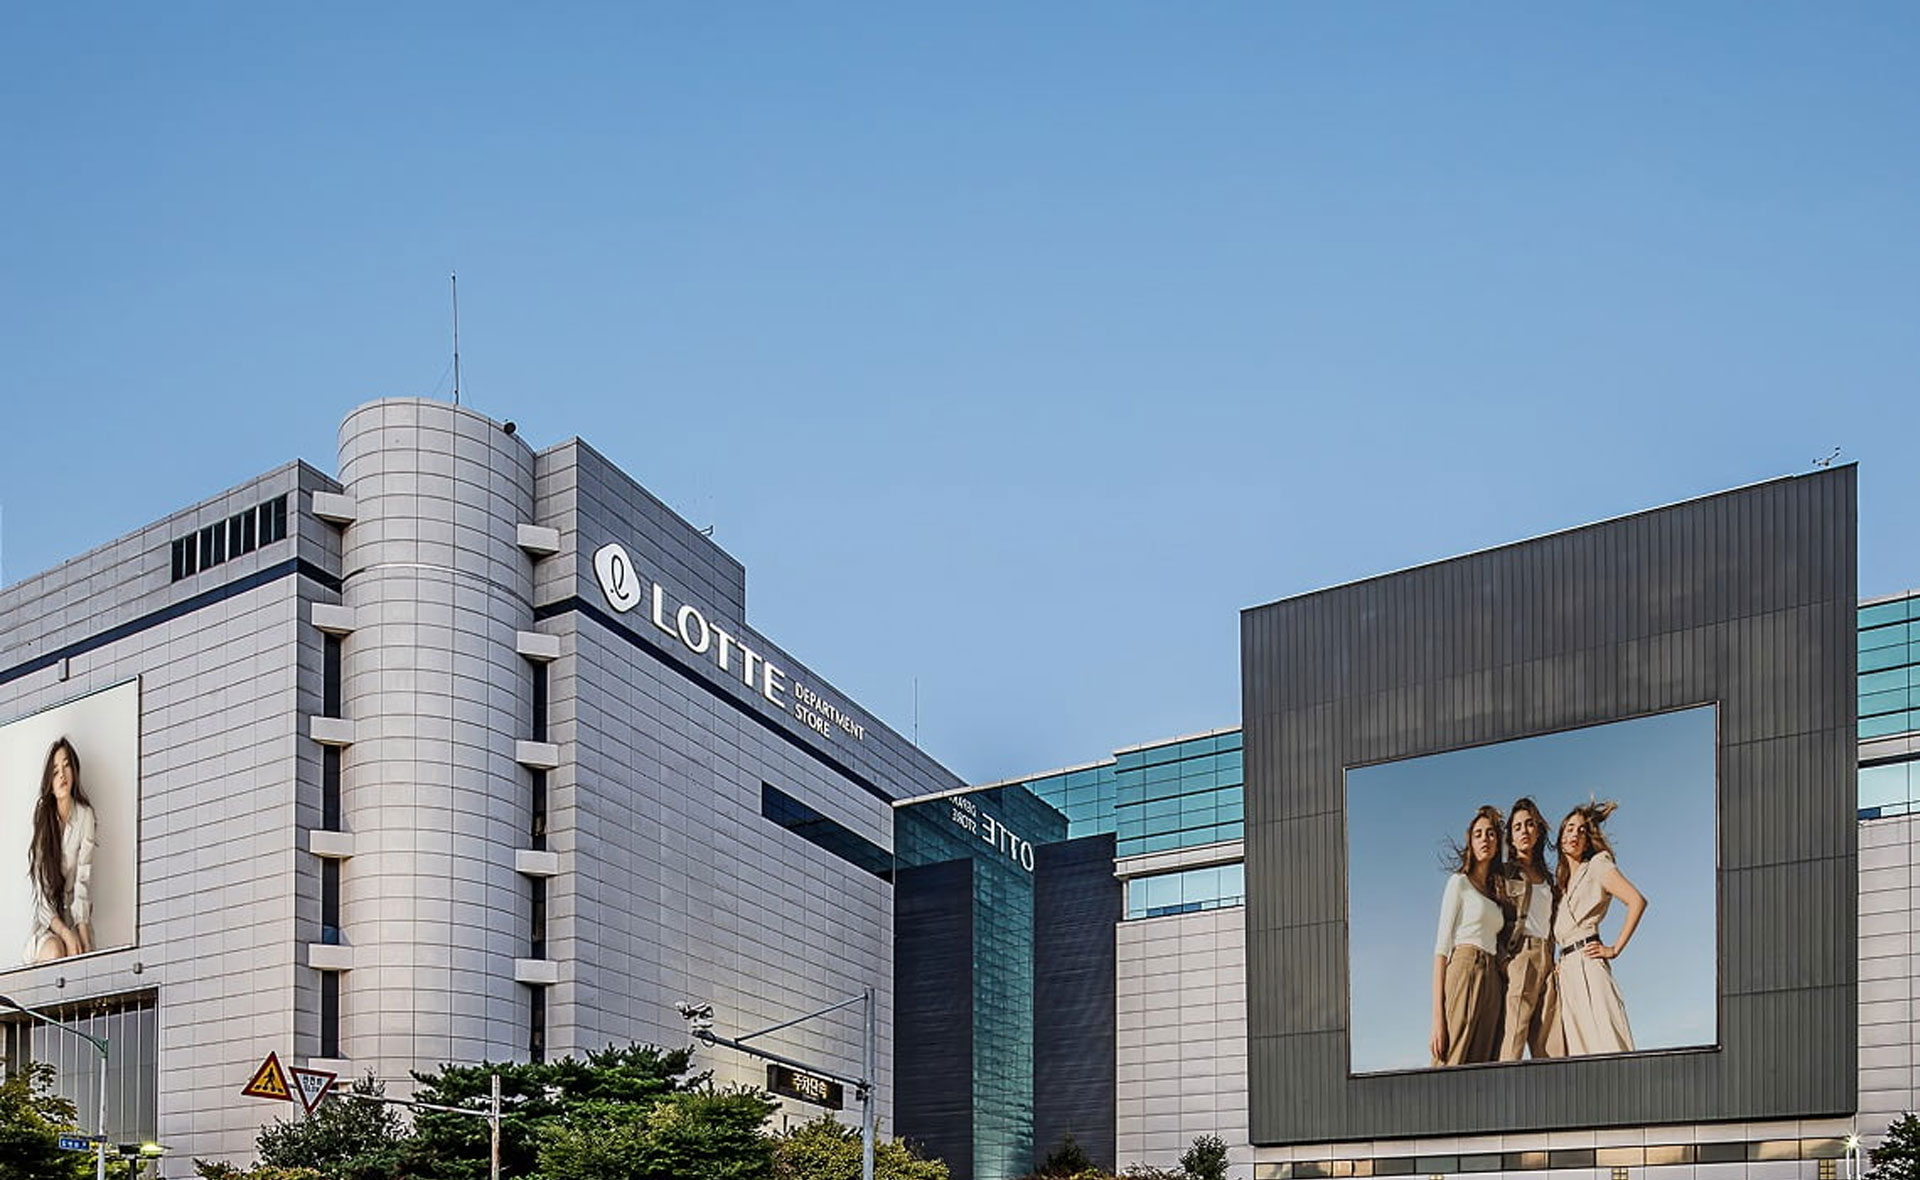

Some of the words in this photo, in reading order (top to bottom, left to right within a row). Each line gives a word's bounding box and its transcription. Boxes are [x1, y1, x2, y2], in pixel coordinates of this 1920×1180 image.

[653, 582, 786, 708] LOTTE
[795, 681, 865, 741] DEPARTMENT
[795, 703, 831, 738] STORE
